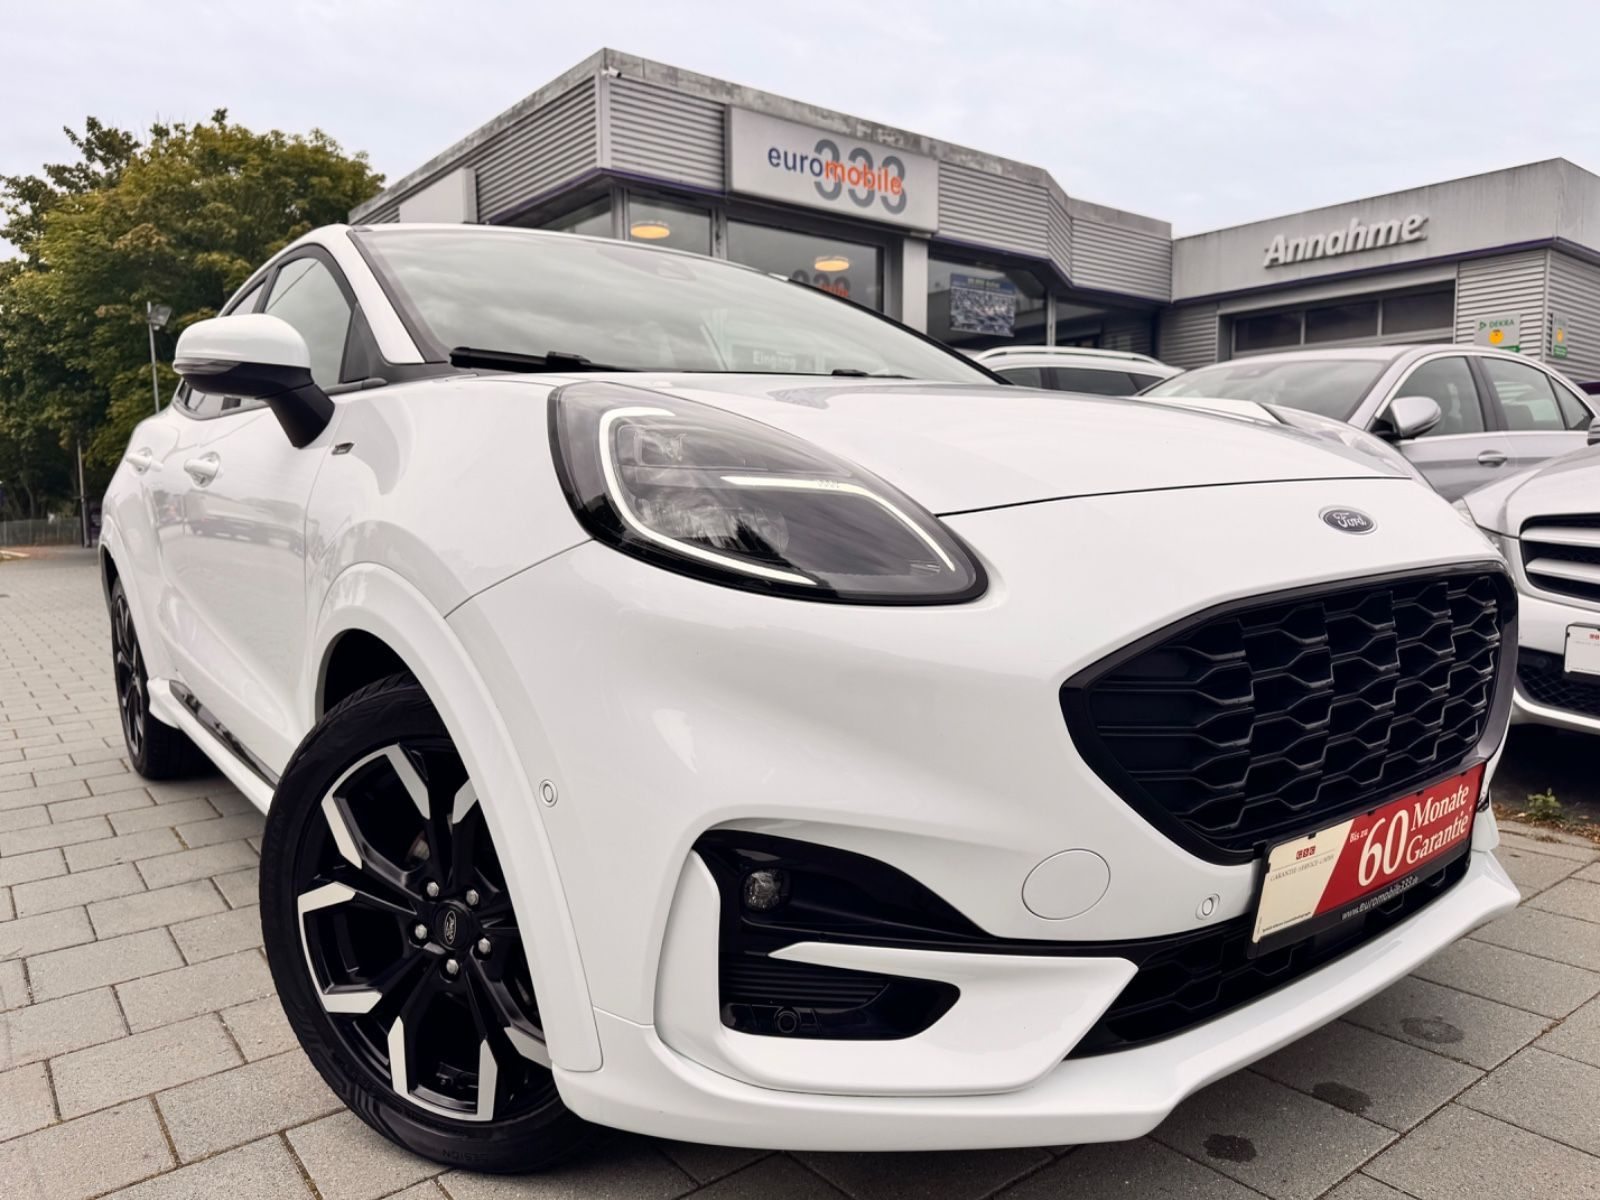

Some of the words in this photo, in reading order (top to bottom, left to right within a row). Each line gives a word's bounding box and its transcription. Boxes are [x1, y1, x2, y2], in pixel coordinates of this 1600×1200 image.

[767, 147, 903, 195] euromobile
[1263, 213, 1429, 269] Annahme
[1489, 318, 1515, 329] DEKRA
[1332, 511, 1367, 528] Ford
[1410, 784, 1470, 832] Monate
[1358, 809, 1409, 887] 60
[1406, 811, 1469, 865] Garantie
